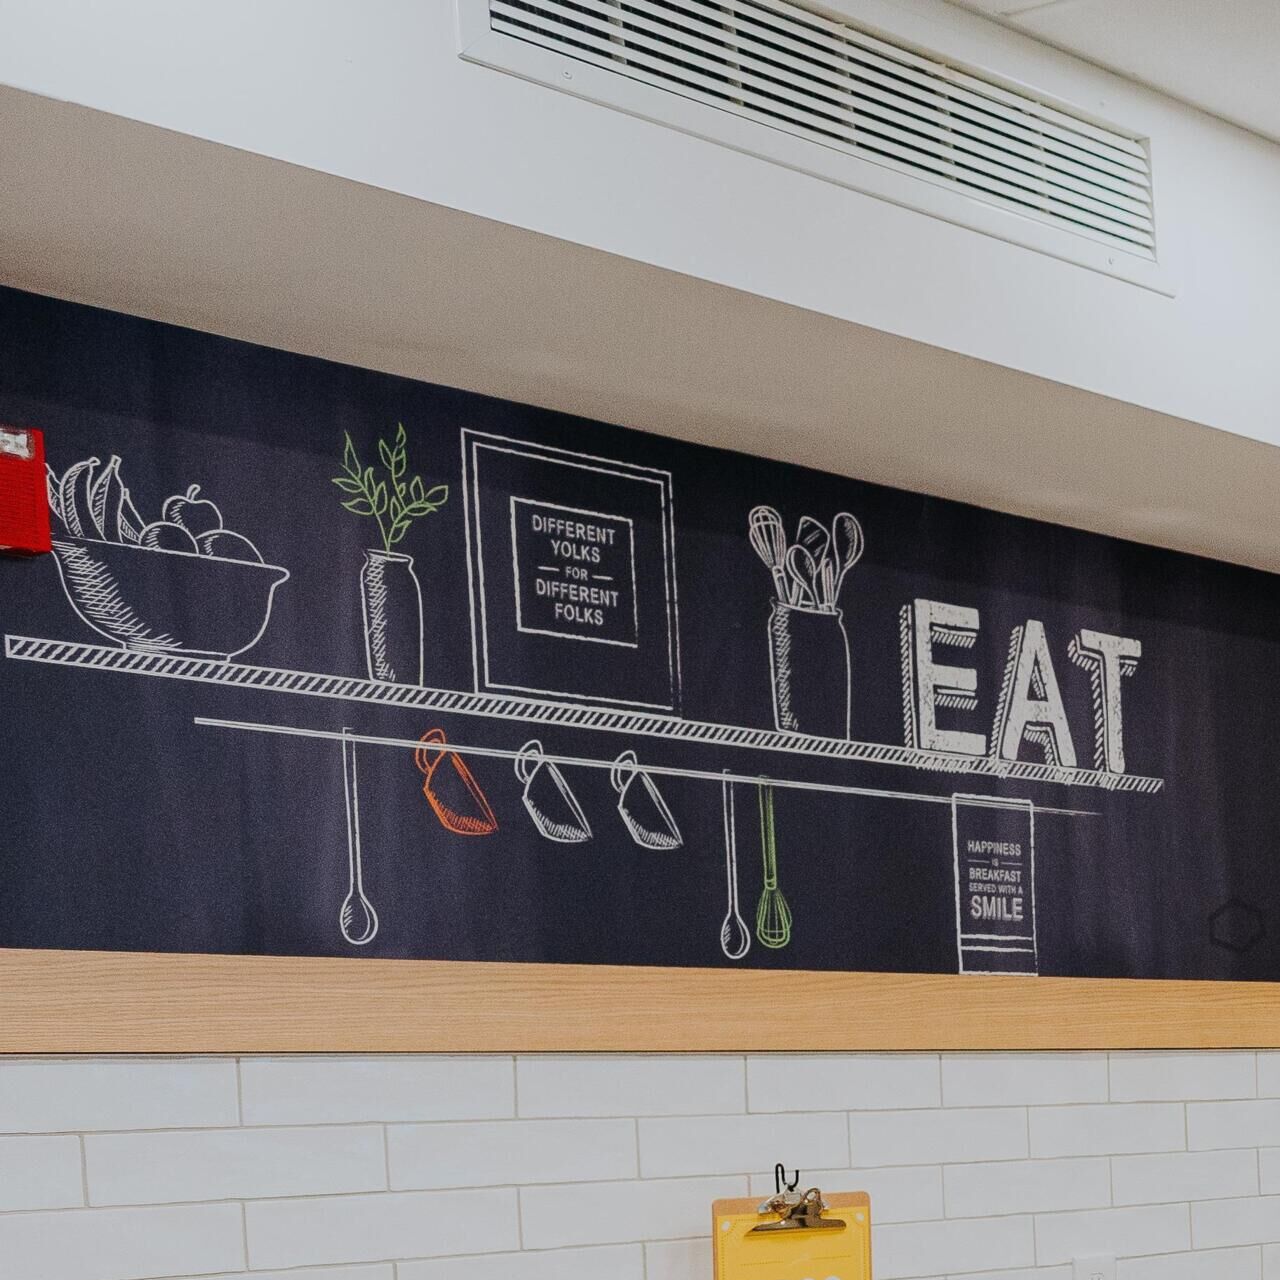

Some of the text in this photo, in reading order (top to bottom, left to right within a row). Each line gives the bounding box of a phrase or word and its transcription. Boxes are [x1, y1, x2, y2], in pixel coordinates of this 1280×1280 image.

[532, 514, 616, 545] DIFFERENT
[551, 539, 601, 563] YOLKS
[565, 566, 588, 580] FOR
[536, 578, 619, 607] DIFFERENT
[554, 602, 604, 625] FOLKS
[900, 598, 1142, 774] EAT
[967, 839, 1022, 856] HAPPINESS
[969, 867, 1021, 883] BREAKFAST
[969, 882, 1024, 895] SERVED WITH A
[971, 895, 1024, 921] SMILE
